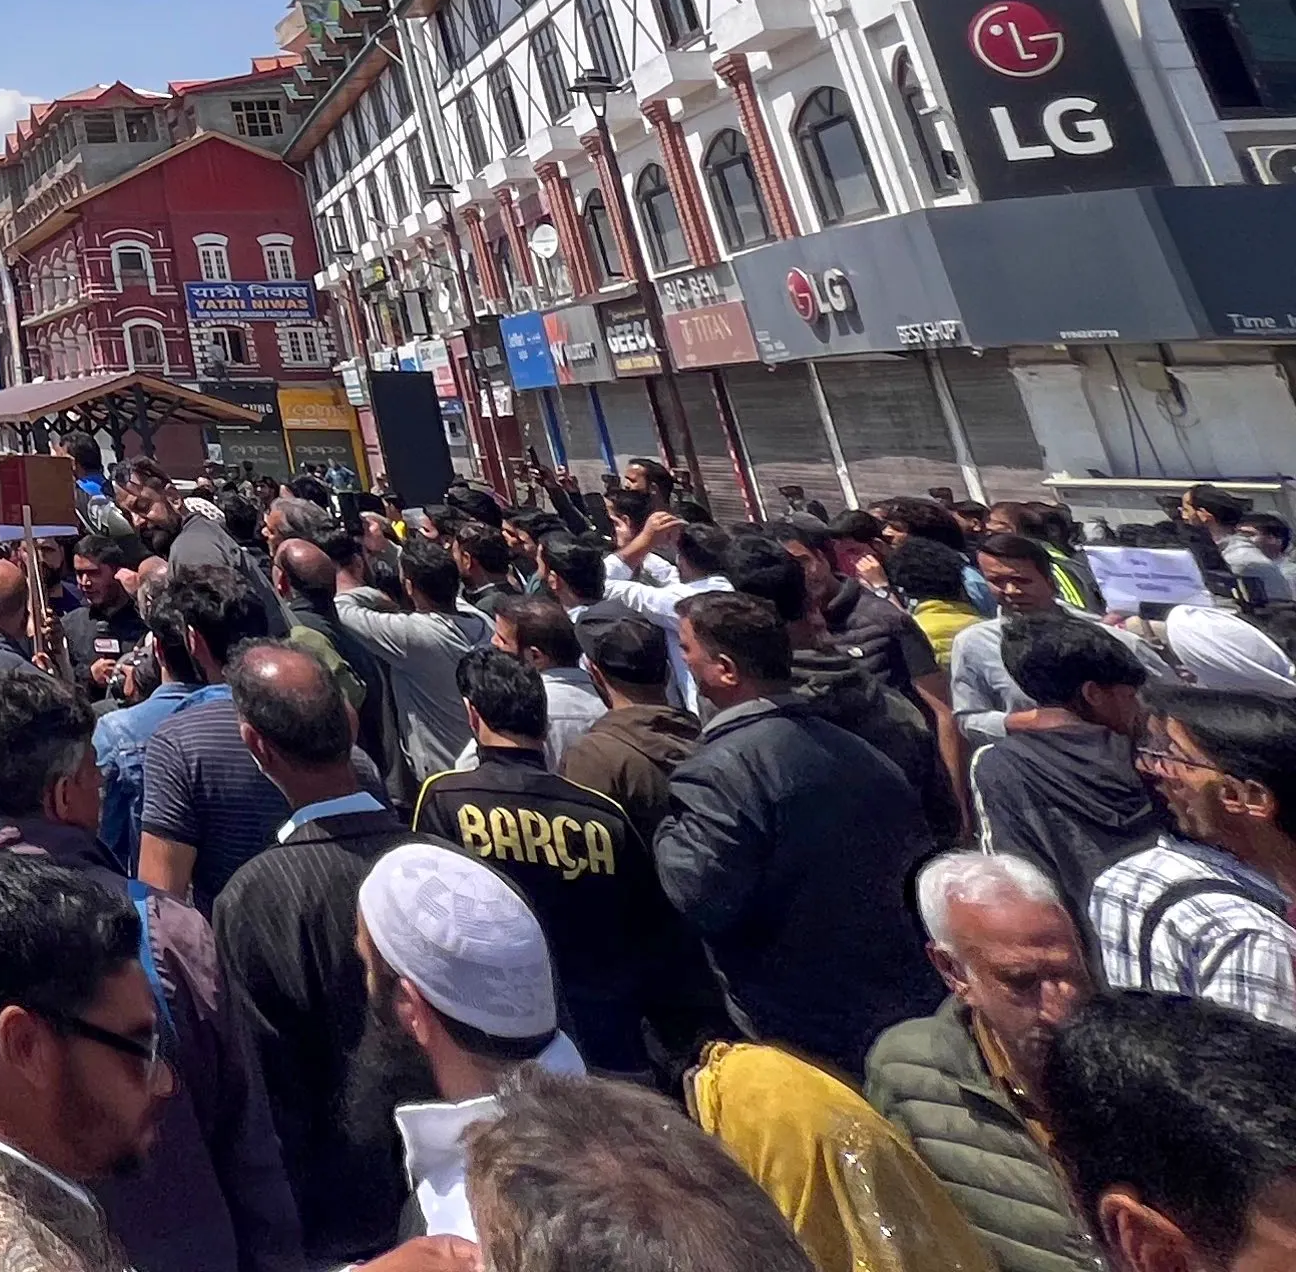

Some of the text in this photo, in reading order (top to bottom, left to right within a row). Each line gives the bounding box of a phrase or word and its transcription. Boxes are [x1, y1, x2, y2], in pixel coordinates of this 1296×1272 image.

[990, 97, 1114, 161] LG
[688, 274, 720, 299] BEN
[810, 268, 848, 314] LG
[195, 299, 308, 310] YATRI NIWAS
[691, 312, 733, 342] TITAN
[896, 321, 961, 344] BEST SHOP
[1226, 313, 1277, 329] Time
[458, 803, 615, 880] BARÇA
